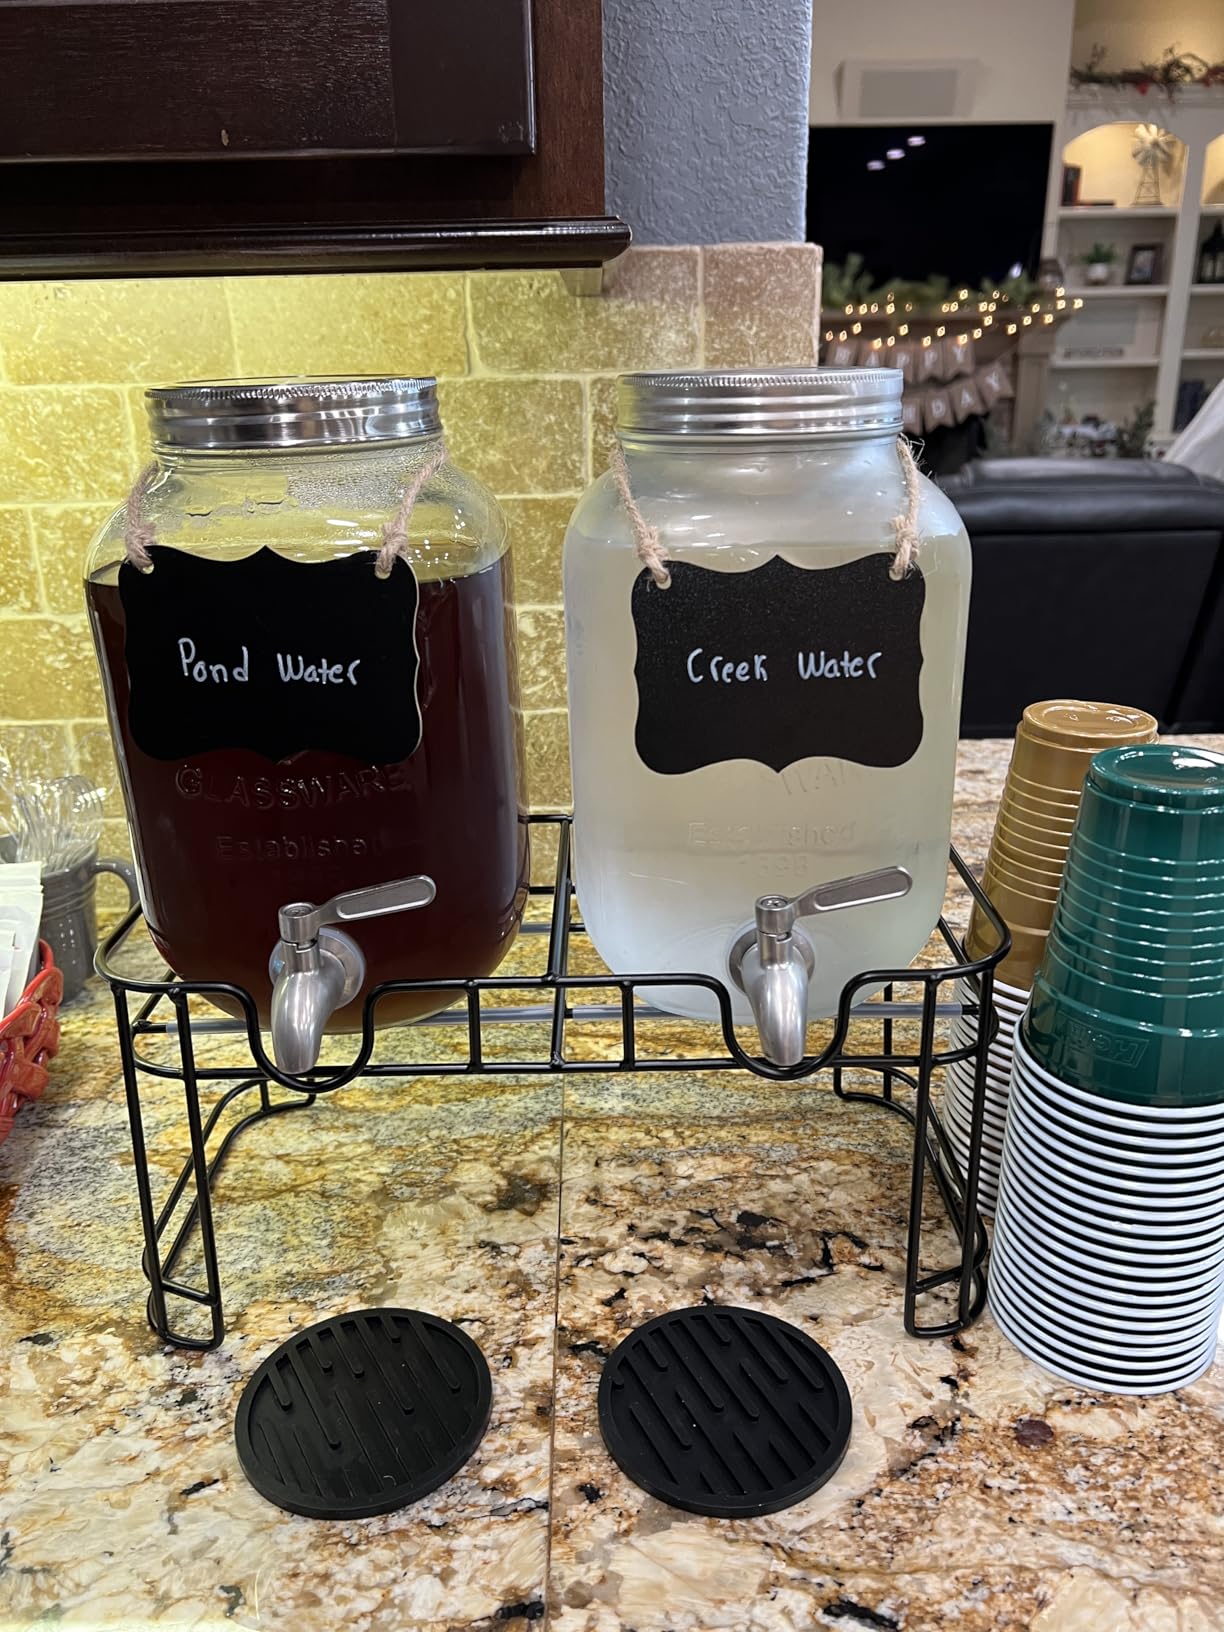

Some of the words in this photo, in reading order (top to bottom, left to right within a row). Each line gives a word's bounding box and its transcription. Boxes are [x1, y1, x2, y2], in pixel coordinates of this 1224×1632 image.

[177, 638, 249, 683] Pond
[276, 653, 361, 685] Water
[686, 648, 769, 683] Creek
[798, 650, 882, 681] Water
[175, 764, 412, 810] GLASSWARE
